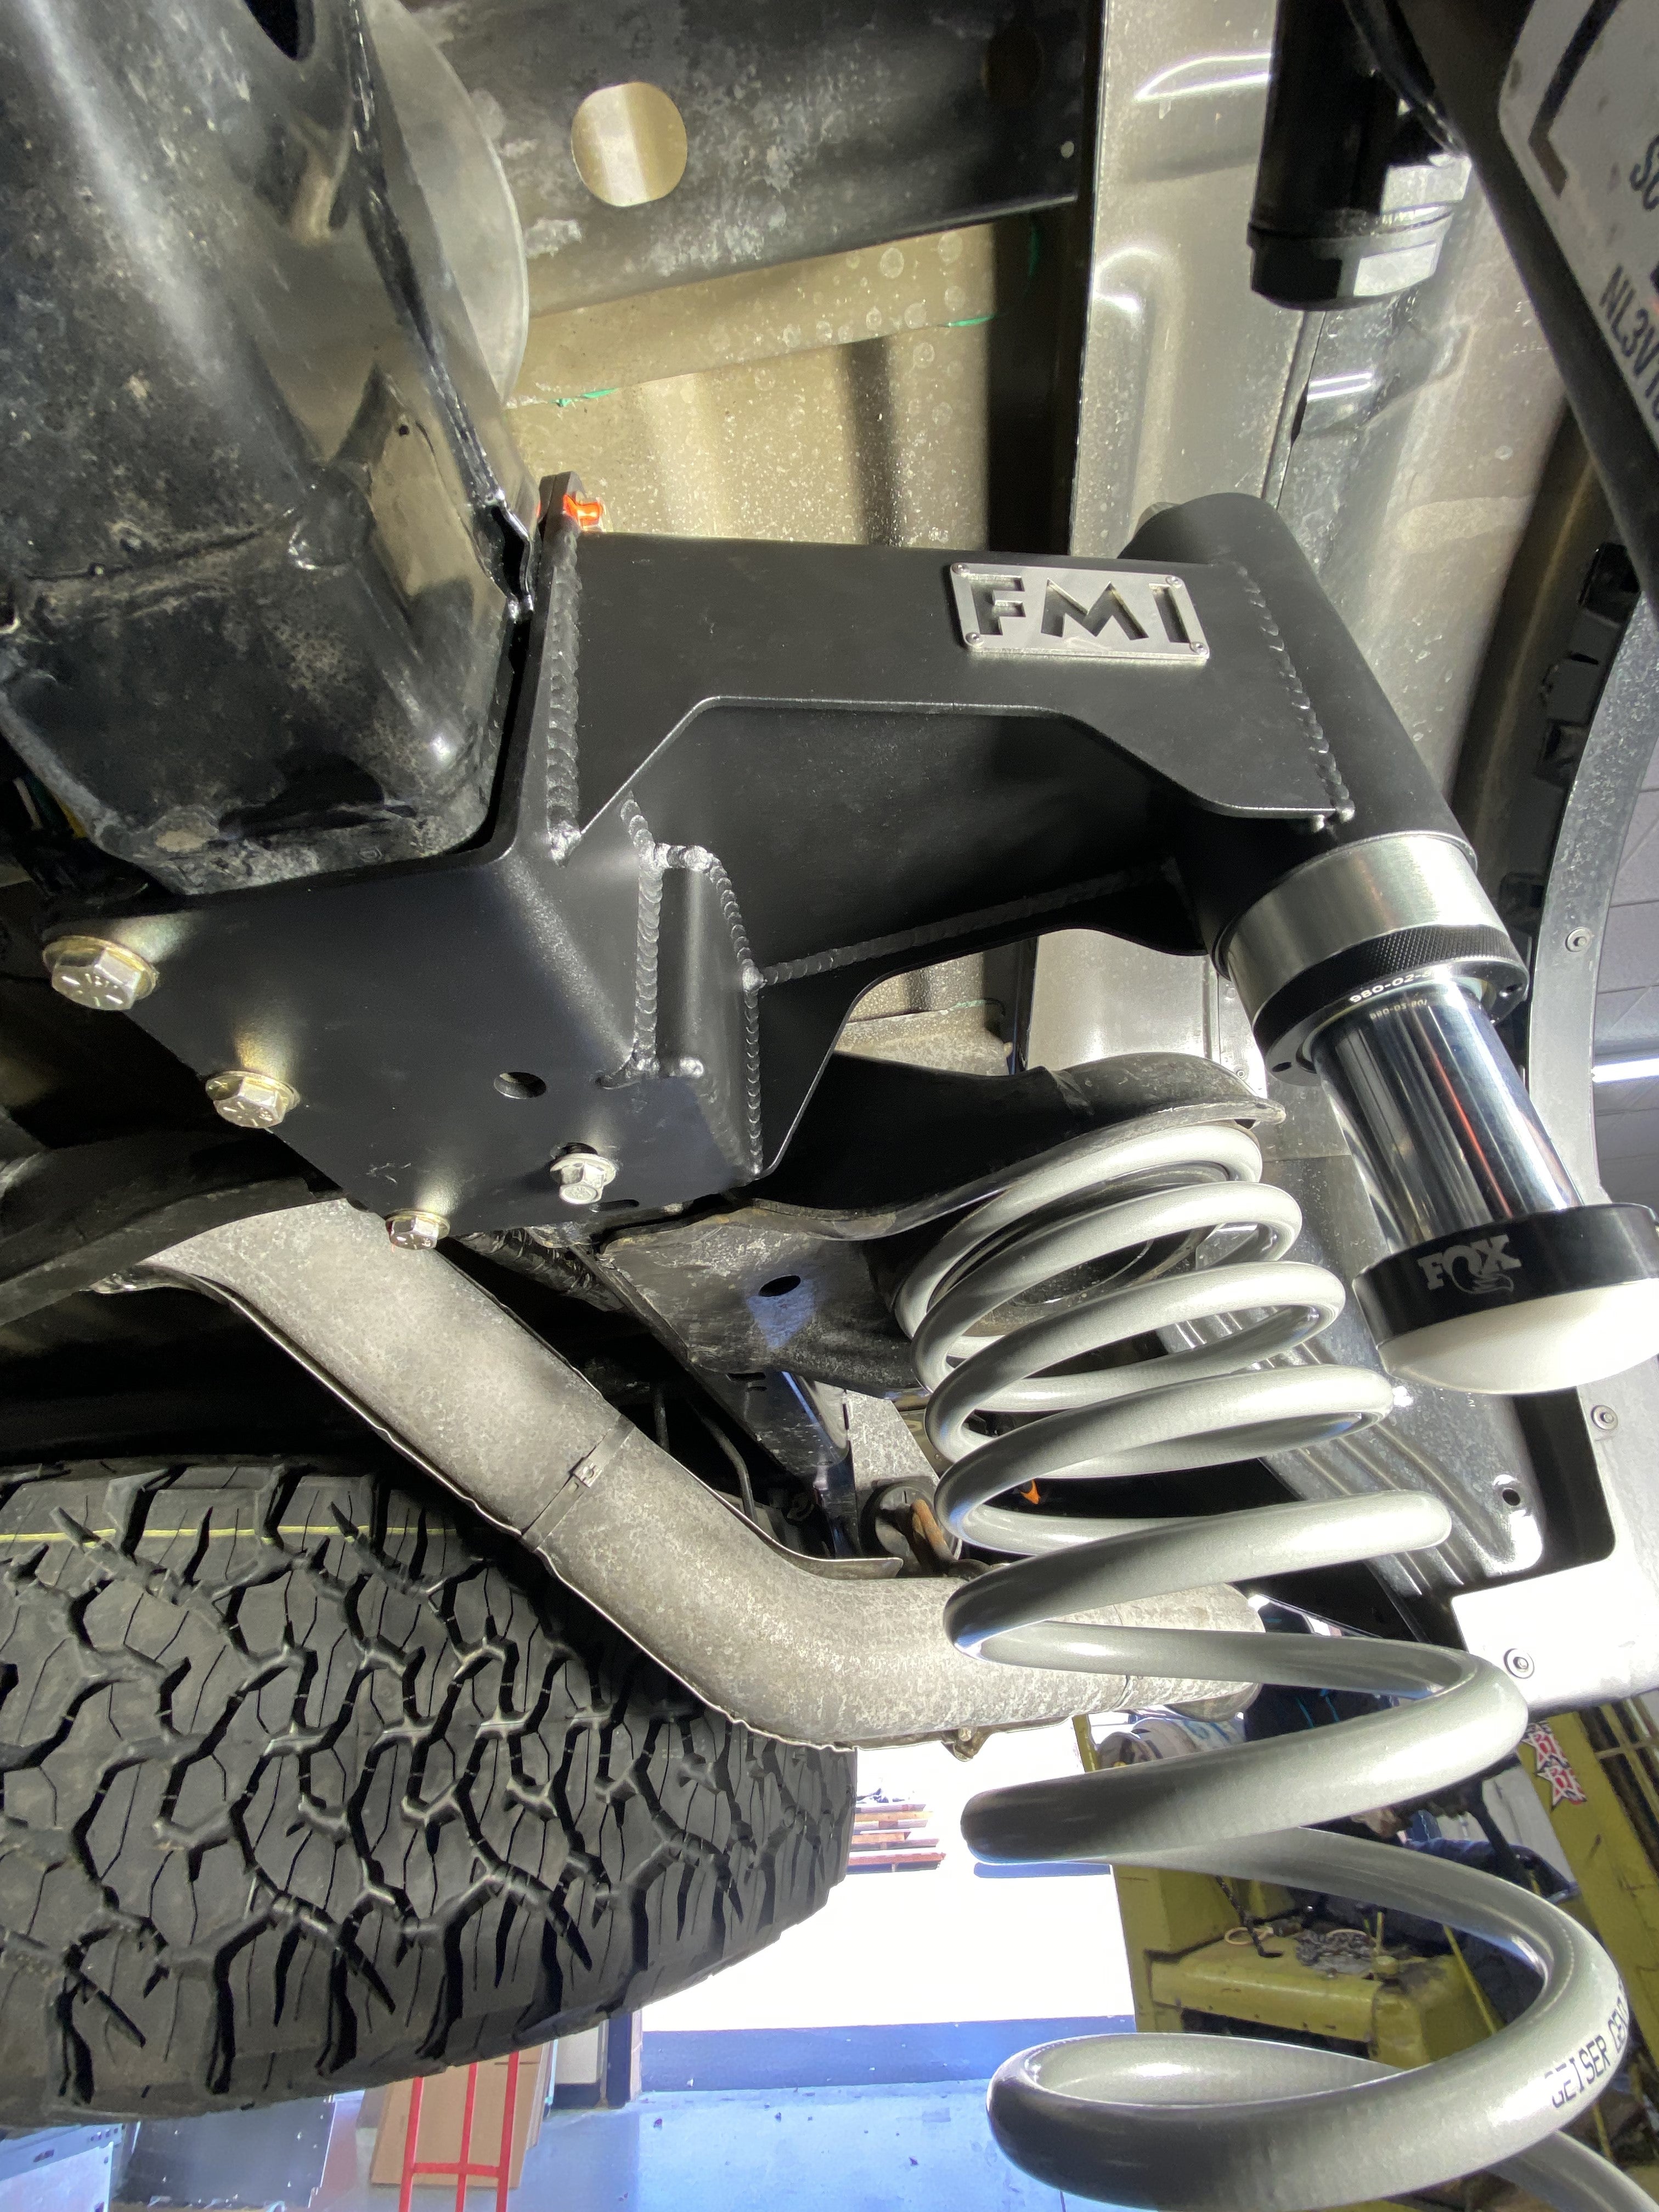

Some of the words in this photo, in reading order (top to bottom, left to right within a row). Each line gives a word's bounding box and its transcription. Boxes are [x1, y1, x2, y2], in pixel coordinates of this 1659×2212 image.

[964, 573, 1191, 644] FMI
[1418, 1234, 1522, 1294] FOX
[1544, 2034, 1610, 2108] GEISER
